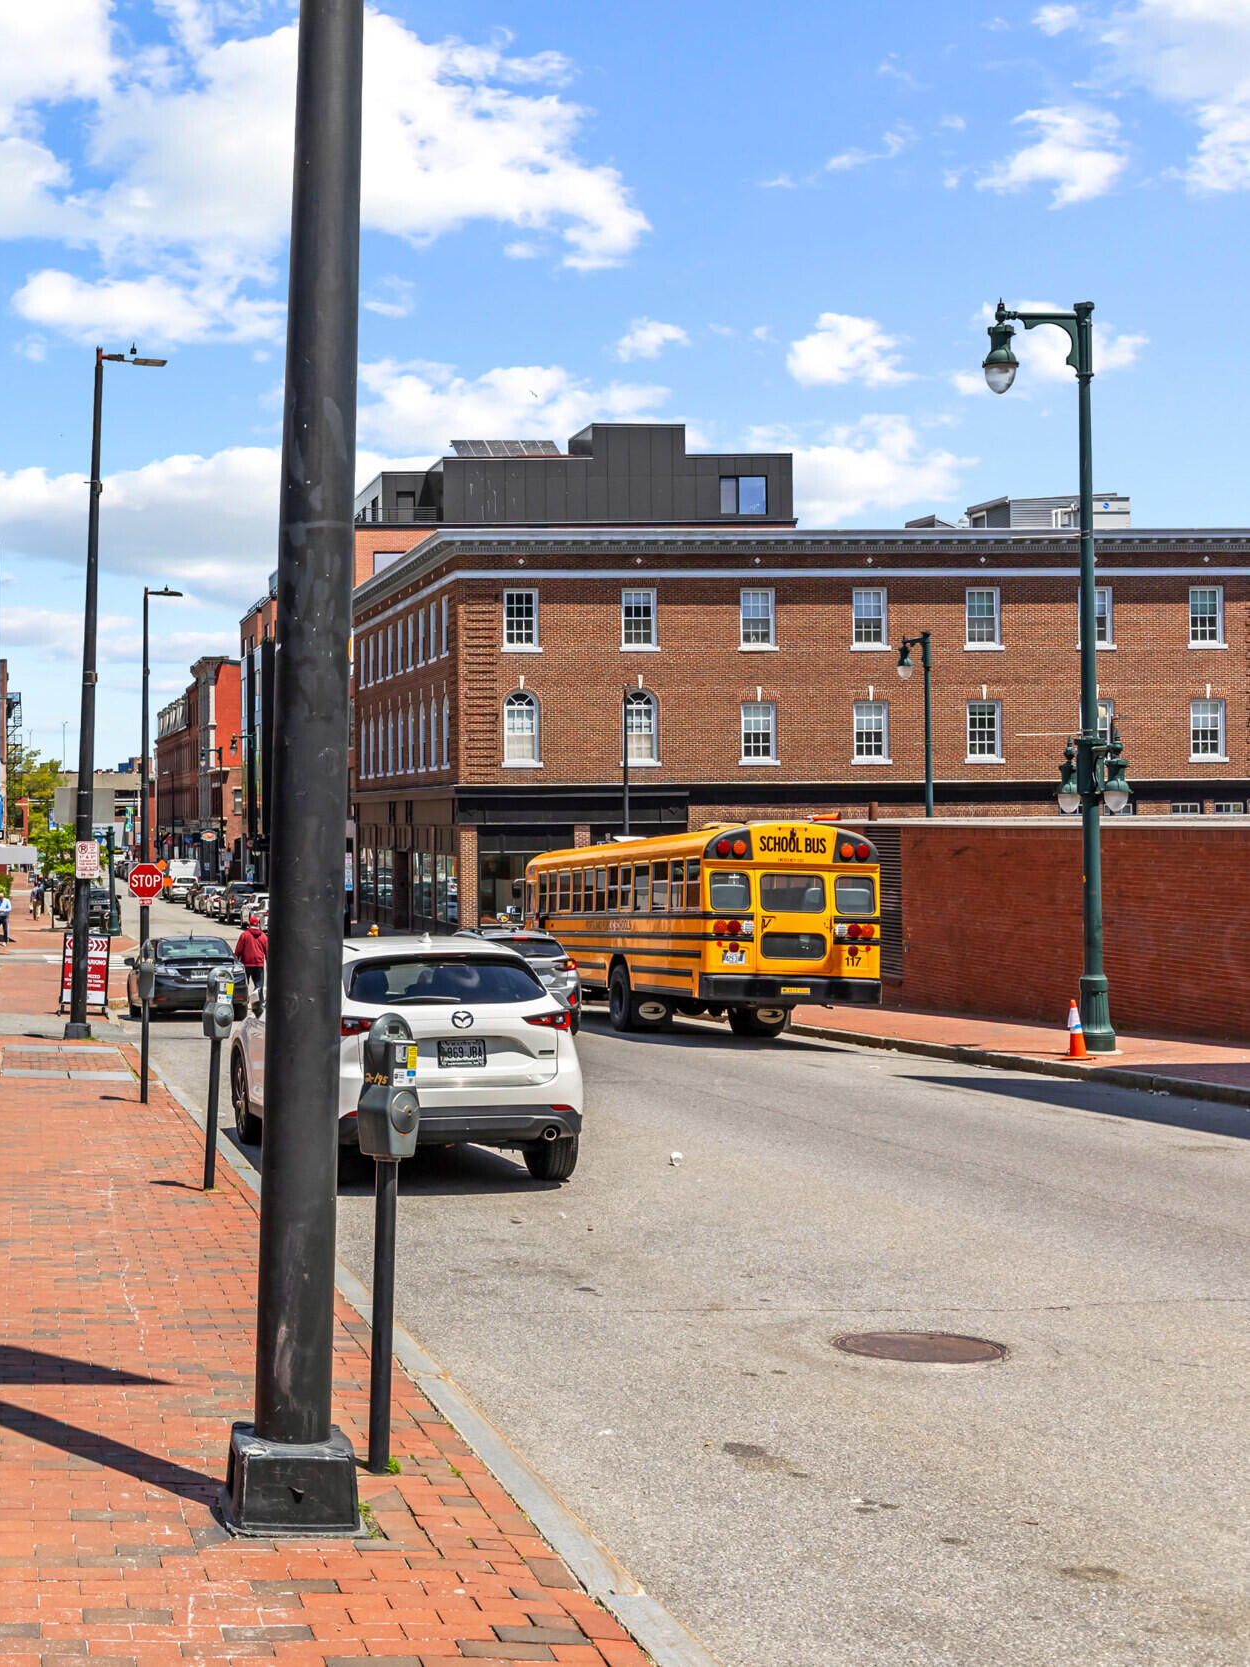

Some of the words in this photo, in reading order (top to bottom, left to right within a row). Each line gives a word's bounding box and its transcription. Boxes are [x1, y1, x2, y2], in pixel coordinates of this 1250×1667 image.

[759, 835, 802, 853] SCHOOL
[805, 837, 826, 854] BUS
[131, 874, 161, 888] STOP
[844, 956, 862, 968] 117
